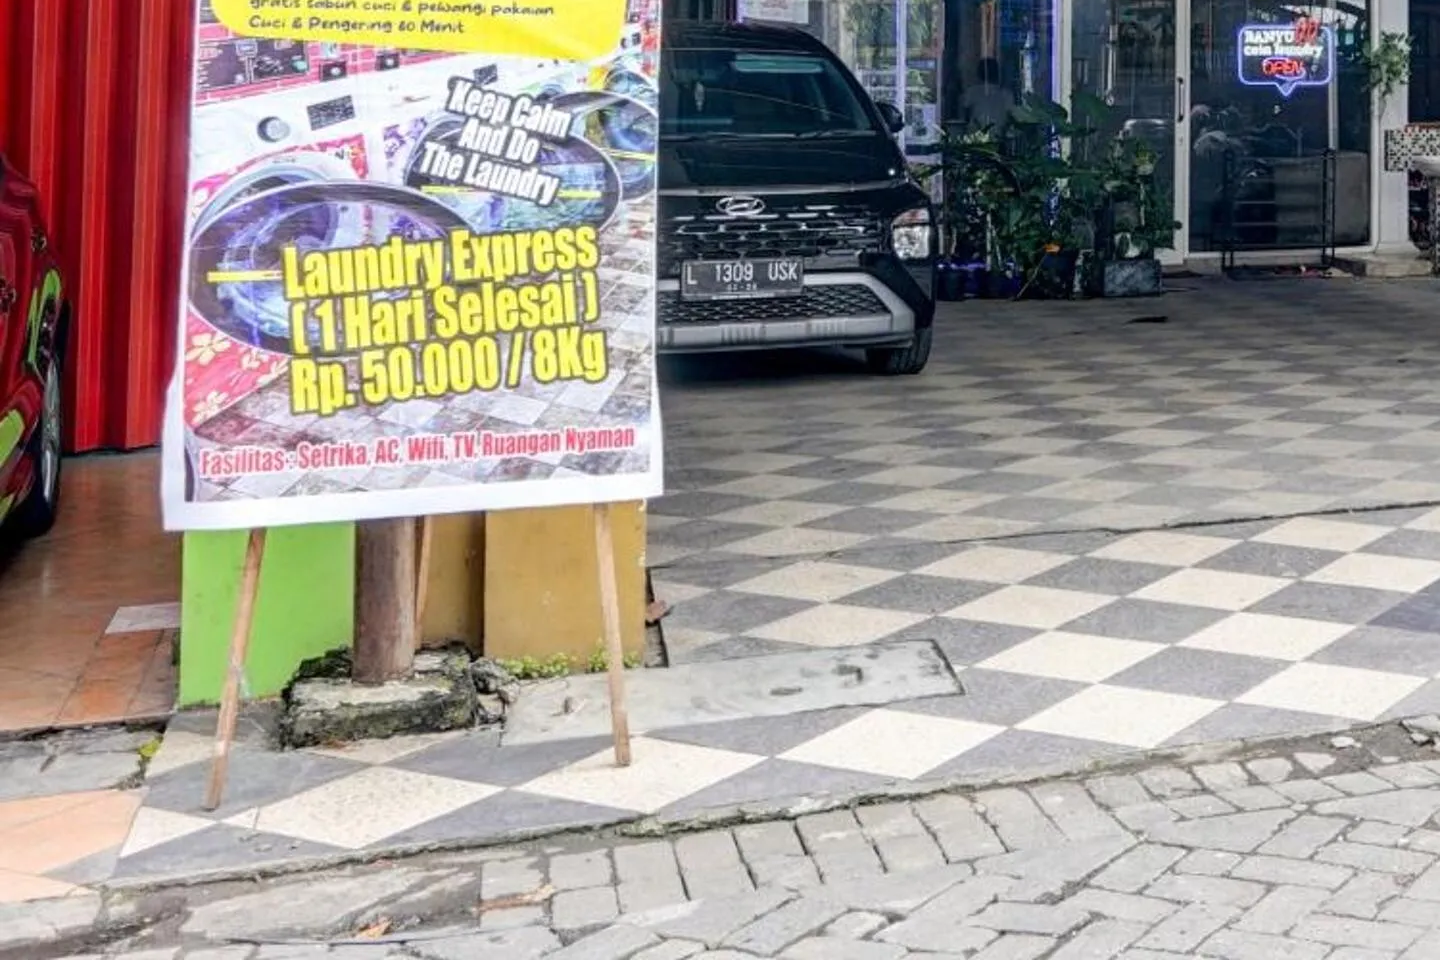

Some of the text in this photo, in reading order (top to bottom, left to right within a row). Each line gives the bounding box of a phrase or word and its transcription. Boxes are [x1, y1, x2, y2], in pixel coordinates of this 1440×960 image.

[249, 15, 286, 28] Cuci
[308, 16, 393, 33] Pengering
[420, 19, 466, 34] Menit
[362, 0, 396, 12] cuci
[418, 1, 486, 16] pewangi
[490, 1, 555, 16] pakaian
[449, 79, 573, 138] Keep Calm
[458, 118, 541, 165] And Do
[419, 141, 561, 206] The Laundry
[283, 225, 598, 299] Laundry Express
[687, 261, 798, 285] L 1309 USK
[314, 298, 337, 352] 1
[344, 289, 427, 348] Hari
[433, 275, 577, 338] Selesai
[290, 326, 608, 415] Rp. 50.000 / 8Kg
[202, 448, 285, 475] Fasilitas
[298, 441, 371, 470] Setrika,
[375, 438, 403, 463] AC,
[408, 435, 449, 461] Wifi,
[483, 430, 562, 456] Ruangan
[565, 427, 635, 453] Nyaman
